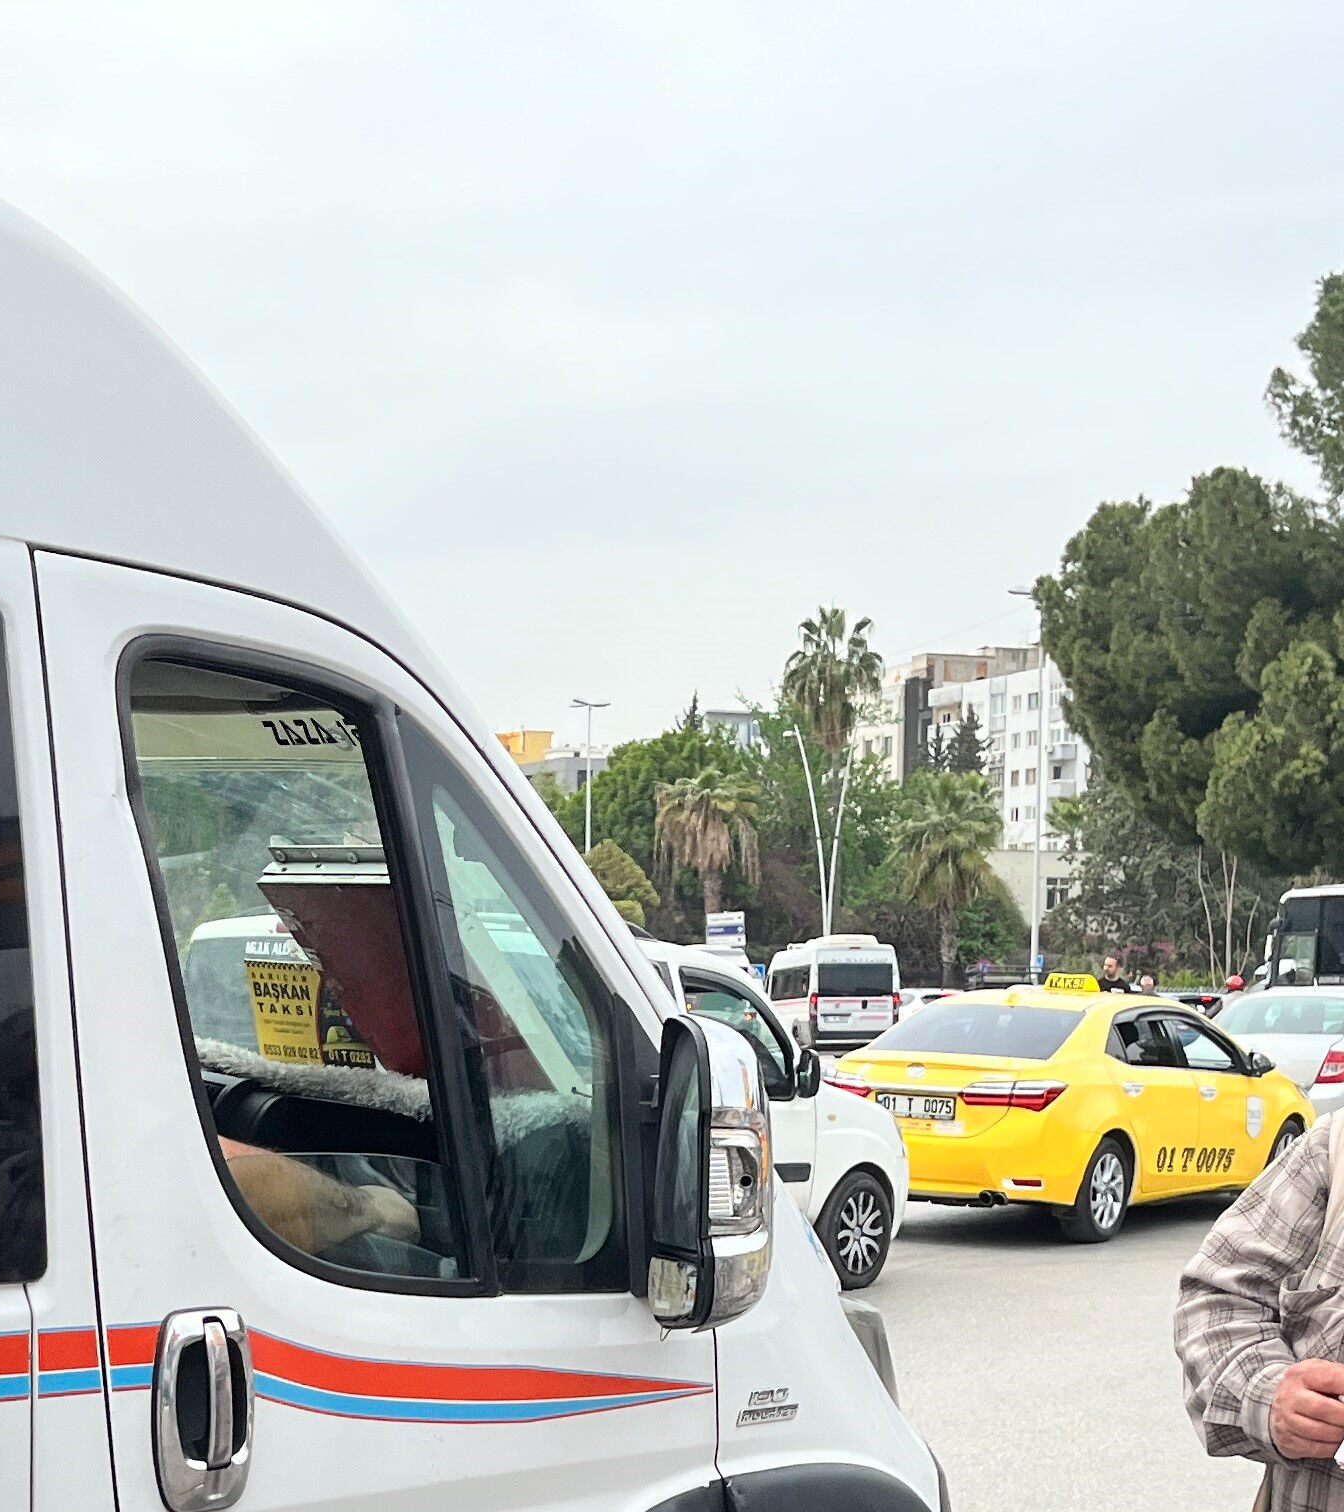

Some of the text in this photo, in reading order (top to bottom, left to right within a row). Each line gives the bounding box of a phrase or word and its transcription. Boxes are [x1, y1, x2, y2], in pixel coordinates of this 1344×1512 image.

[253, 981, 310, 1003] BAŞKAN
[884, 1096, 952, 1115] 01 T 0075
[1156, 1146, 1236, 1173] 01 T 0075
